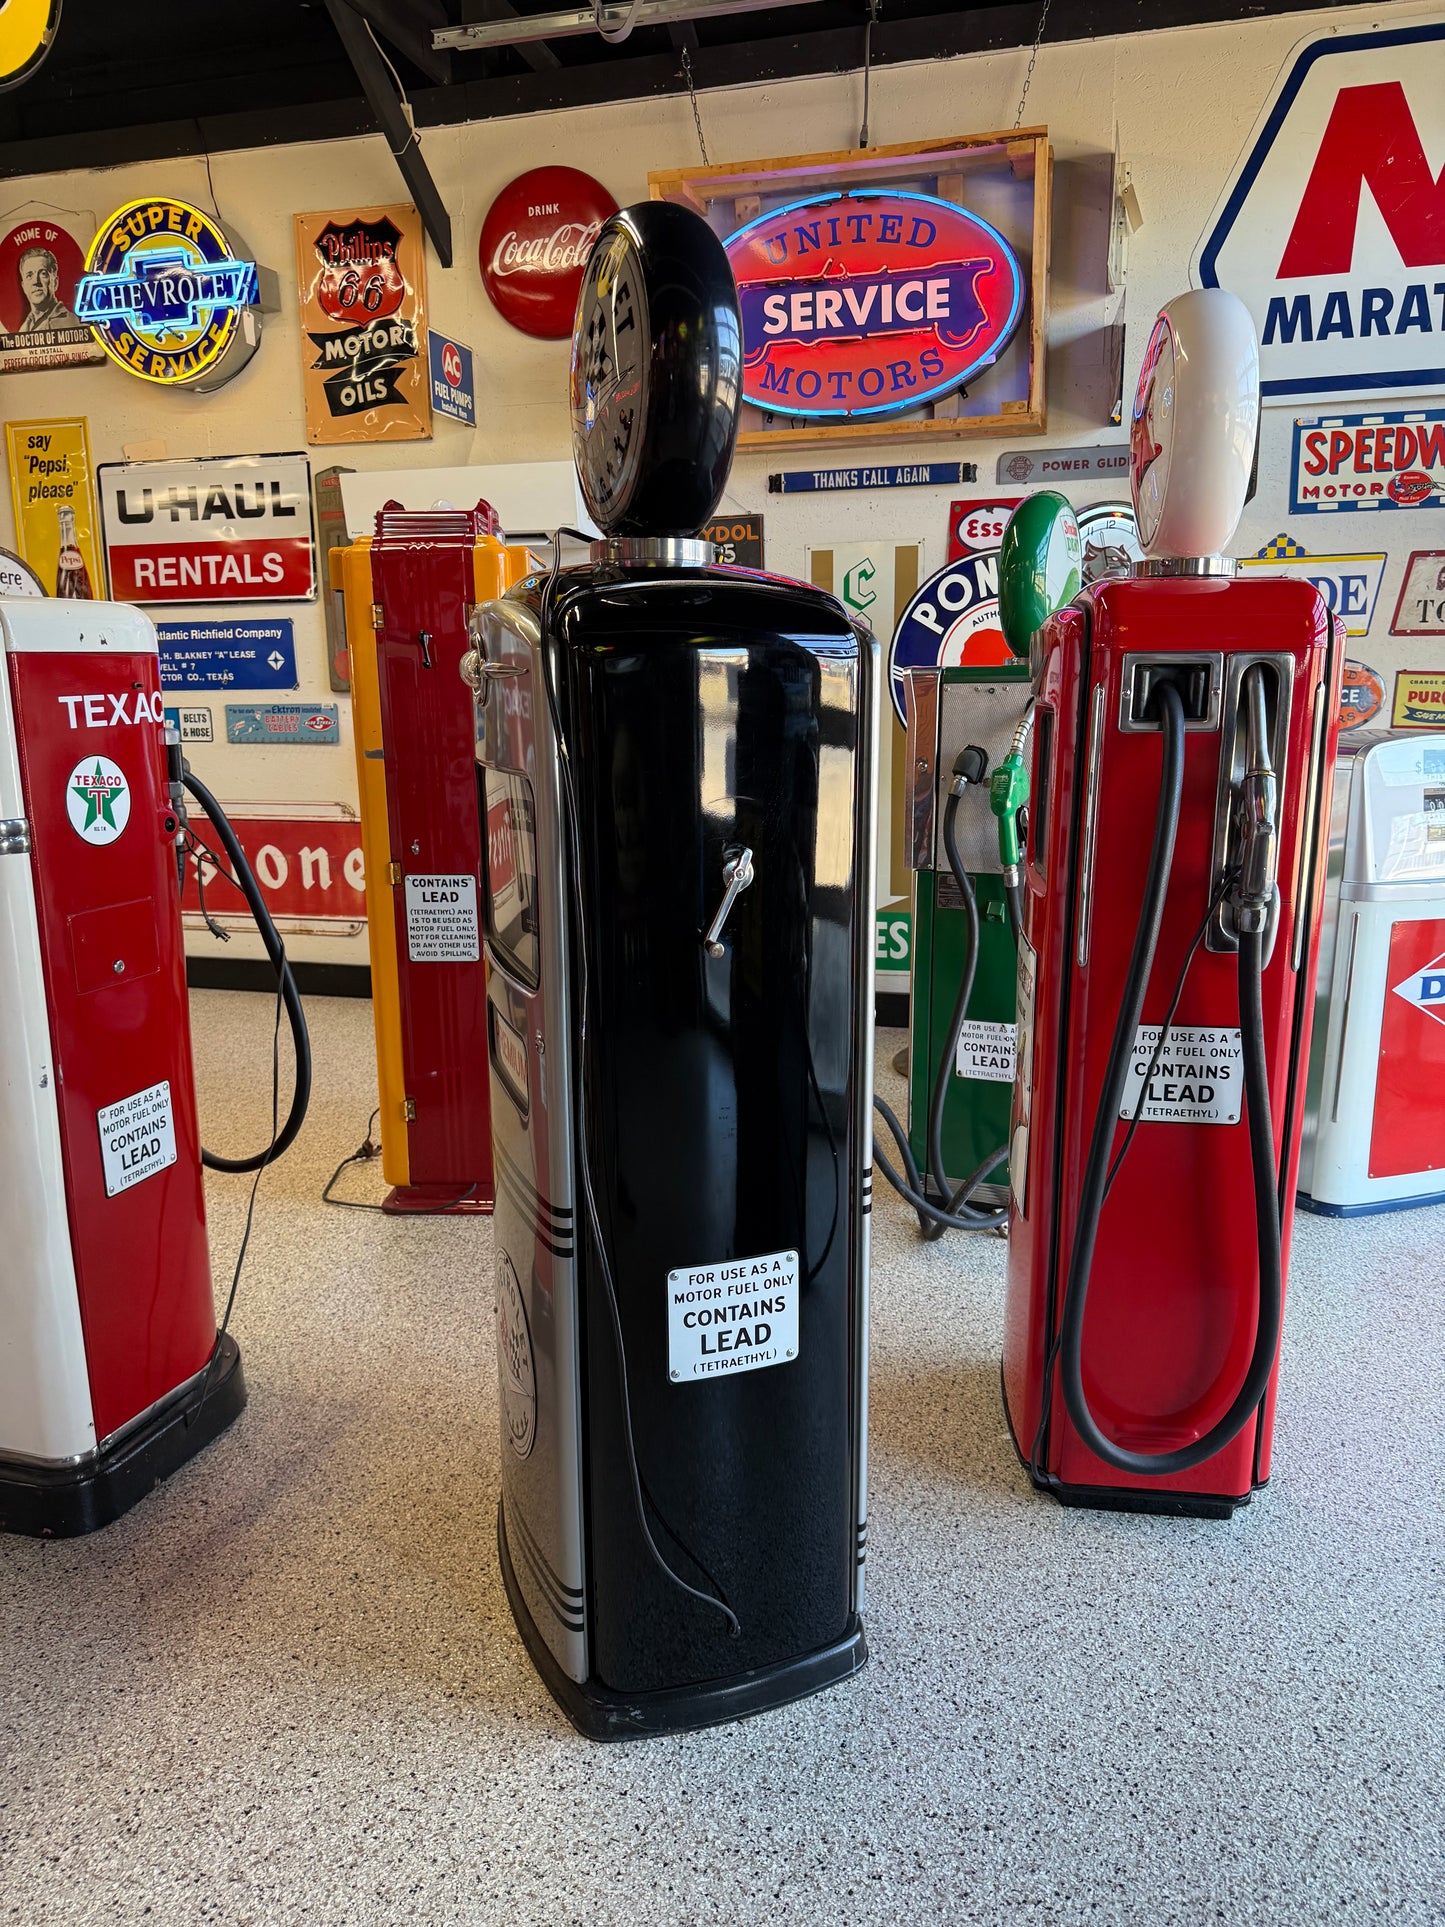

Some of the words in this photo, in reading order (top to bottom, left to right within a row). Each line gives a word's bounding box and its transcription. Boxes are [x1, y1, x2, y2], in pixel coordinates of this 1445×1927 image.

[528, 203, 559, 217] DRINK
[13, 227, 41, 246] HOME
[44, 229, 58, 242] OF
[111, 206, 204, 251] SUPER
[761, 213, 937, 264] UNITED
[322, 231, 393, 262] Phillips
[92, 272, 240, 311] CHEVROLET
[338, 271, 384, 312] 66
[762, 278, 950, 334] SERVICE
[1, 336, 14, 348] The
[15, 332, 45, 347] DOCTOR
[45, 331, 56, 344] OF
[57, 328, 89, 343] MOTORS
[324, 326, 404, 361] MOTOR
[117, 323, 230, 378] SERVICE
[444, 352, 461, 378] AC
[759, 347, 944, 399] MOTORS
[340, 378, 388, 407] OILS
[434, 380, 450, 401] FUEL
[450, 387, 473, 410] PUMPS
[27, 435, 52, 452] say
[1042, 459, 1090, 472] POWER
[1097, 456, 1130, 468] GLID
[812, 470, 858, 488] THANKS
[862, 468, 890, 486] CALL
[895, 466, 930, 483] AGAIN
[1302, 482, 1384, 500] MOTOR
[116, 481, 296, 524] U-HAUL
[967, 519, 1003, 539] Ess
[1107, 520, 1116, 529] 12
[60, 554, 82, 569] Pepsi
[133, 552, 285, 588] RENTALS
[972, 610, 1000, 628] AUTH
[190, 628, 233, 640] Richfield
[235, 627, 282, 641] Company
[174, 651, 213, 660] BLAKNEY
[229, 650, 256, 659] LEASE
[190, 662, 196, 670] 7
[187, 673, 205, 681] CO.,
[206, 672, 234, 681] TEXAS
[183, 713, 207, 723] BELTS
[264, 715, 300, 723] BATTERY
[271, 705, 300, 714] Ektron
[182, 727, 189, 737] &
[190, 727, 210, 737] HOSE
[267, 724, 299, 733] CABLES
[75, 775, 122, 787] TEXACO
[88, 789, 110, 815] T
[412, 878, 469, 888] CONTAINS
[422, 891, 459, 903] LEAD
[410, 908, 455, 916] (TETRAETHYL)
[961, 1031, 984, 1040] MOTOR
[986, 1034, 1003, 1042] FUEL
[968, 1023, 981, 1031] FOR
[1170, 1032, 1195, 1042] USE
[1198, 1033, 1215, 1043] AS
[1219, 1034, 1228, 1044] A
[1131, 1045, 1170, 1056] MOTR
[1175, 1046, 1206, 1057] FUEL
[1210, 1047, 1241, 1058] ONLY
[972, 1055, 1010, 1069] LEAD
[1134, 1061, 1231, 1080] CONTAINS
[1148, 1083, 1215, 1104] LEAD
[109, 1105, 125, 1120] FOR
[127, 1097, 142, 1111] USE
[143, 1092, 154, 1104] AS
[155, 1089, 162, 1098] A
[1141, 1106, 1219, 1119] (TETRAETHYL)
[103, 1117, 131, 1136] MOTOR
[132, 1108, 151, 1123] FUEL
[151, 1097, 170, 1113] ONLY
[110, 1115, 167, 1153] CONTAINS
[121, 1137, 161, 1171] LEAD
[120, 1155, 166, 1187] (TETRAETHYL)
[688, 1272, 715, 1286] FOR
[721, 1266, 747, 1281] USE
[750, 1262, 768, 1276] AS
[772, 1260, 781, 1271] A
[674, 1287, 722, 1304] MOTOR
[727, 1281, 759, 1297] FUEL
[763, 1273, 794, 1290] ONLY
[683, 1295, 786, 1329] CONTAINS
[701, 1322, 772, 1355] LEAD
[693, 1347, 777, 1374] (TETRAETHYL)
